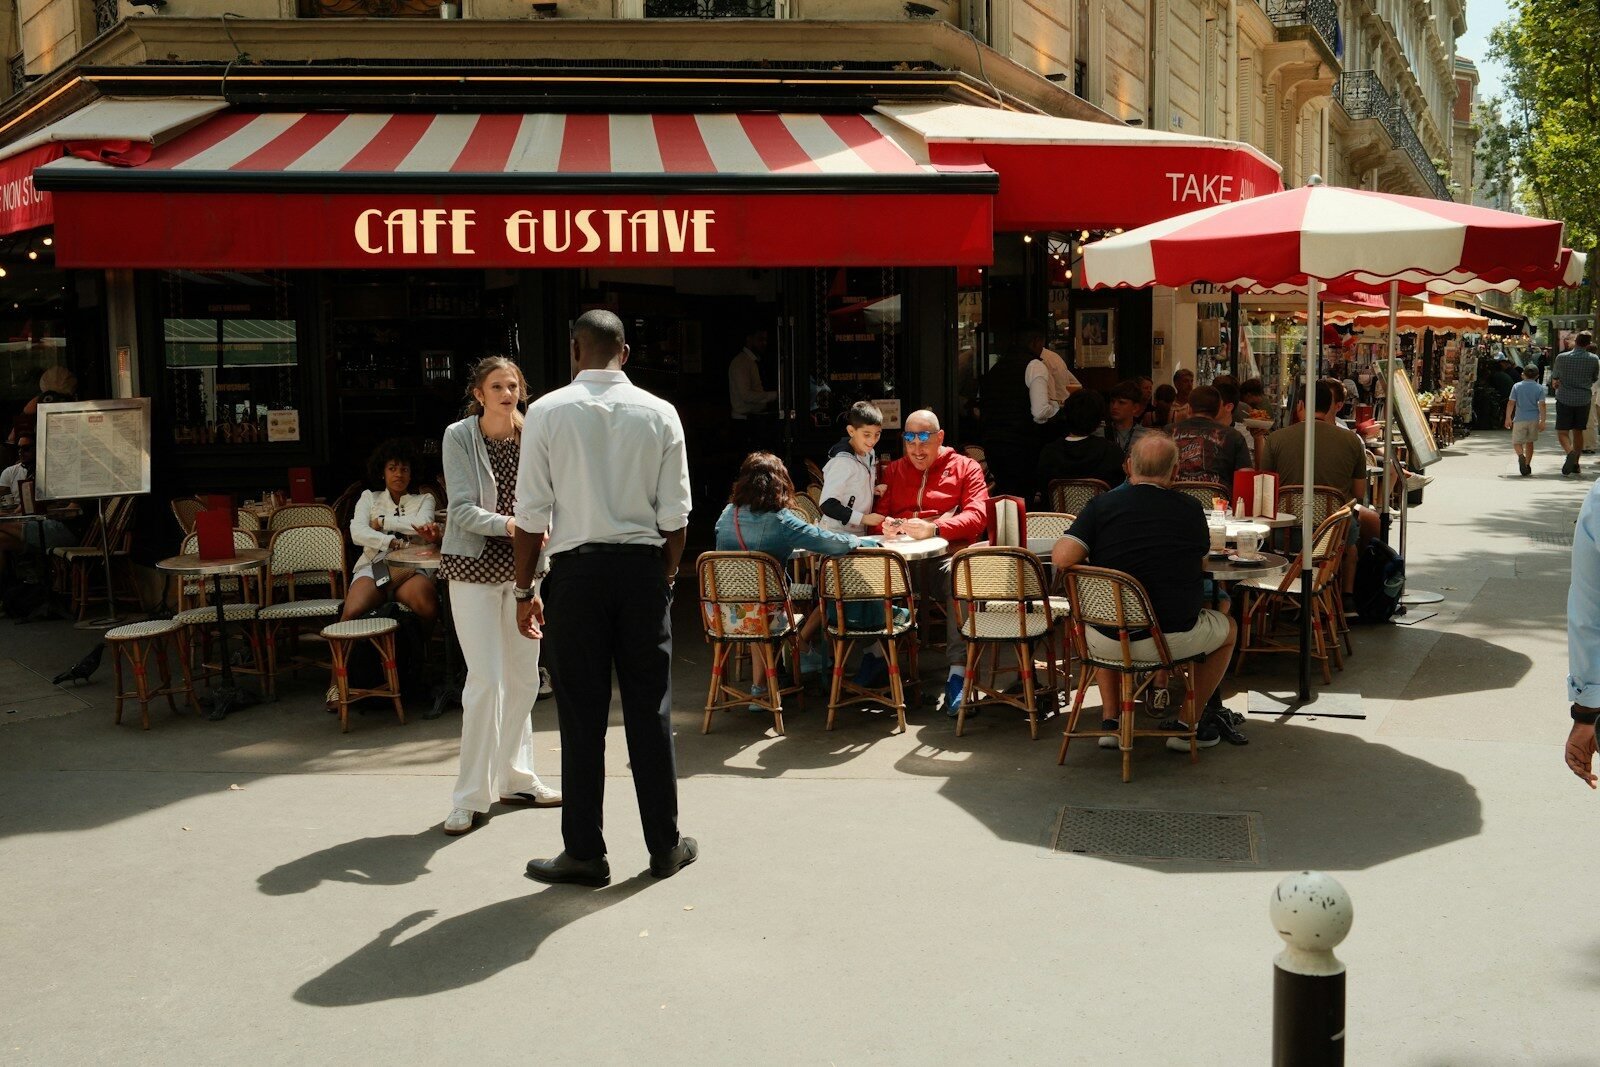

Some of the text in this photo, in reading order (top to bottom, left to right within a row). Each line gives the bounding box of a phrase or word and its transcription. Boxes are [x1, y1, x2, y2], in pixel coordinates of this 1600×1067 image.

[3, 178, 21, 212] NON
[1165, 173, 1233, 203] TAKE
[354, 209, 716, 254] CAFE GUSTAVE
